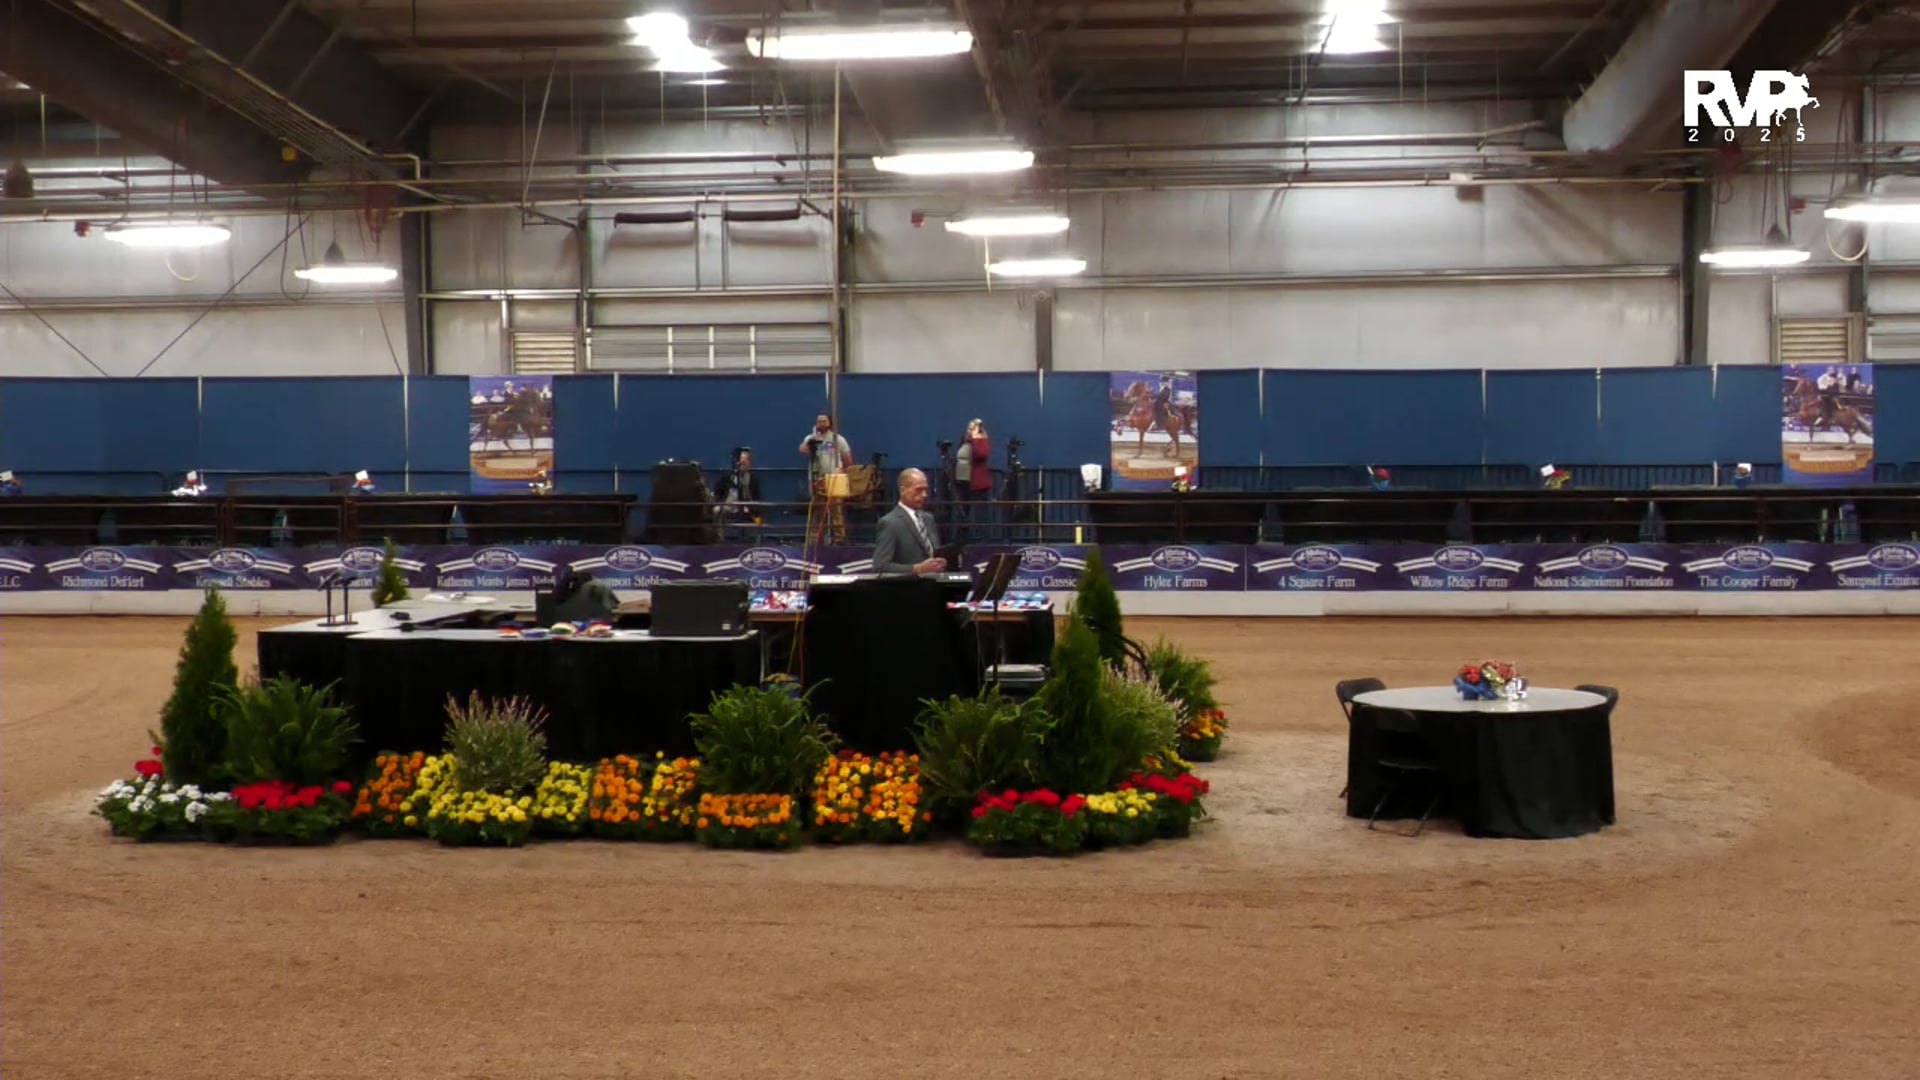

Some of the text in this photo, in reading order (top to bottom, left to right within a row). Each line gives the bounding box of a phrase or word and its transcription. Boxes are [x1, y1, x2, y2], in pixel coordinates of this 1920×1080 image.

[62, 576, 107, 588] Richmond
[750, 576, 778, 588] Creek
[1008, 576, 1077, 588] adison Classic
[1175, 576, 1208, 588] Farms
[1278, 576, 1356, 590] 4 Square Farm
[1411, 576, 1508, 590] Willow Ridge Farm
[1534, 576, 1569, 588] National
[1625, 576, 1674, 588] Foundation
[1698, 576, 1798, 590] The Cooper Family
